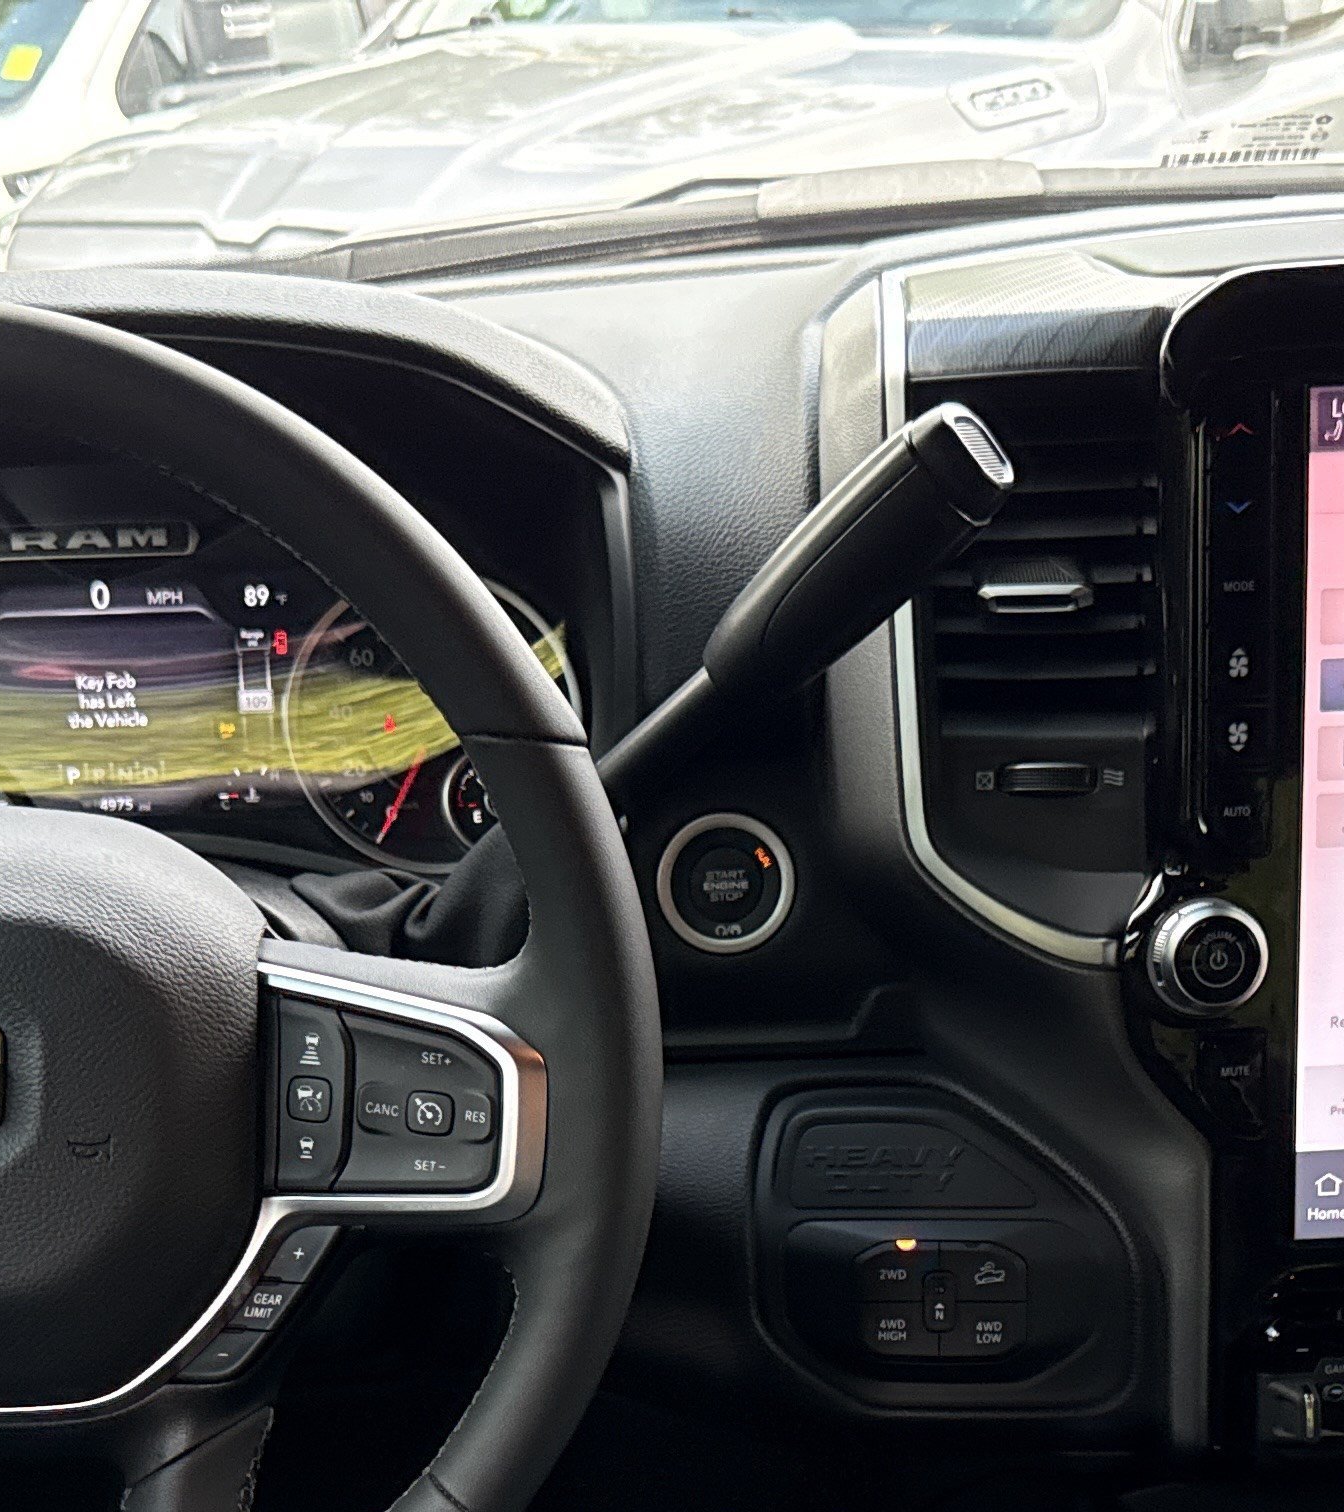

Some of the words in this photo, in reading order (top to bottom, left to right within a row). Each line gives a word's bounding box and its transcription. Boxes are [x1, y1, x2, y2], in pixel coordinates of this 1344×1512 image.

[9, 527, 168, 551] RAM
[1223, 581, 1255, 593] MODE
[89, 579, 111, 610] 0
[145, 587, 184, 606] MPH
[243, 583, 270, 608] 89
[349, 649, 374, 667] 60
[76, 673, 104, 692] Key
[106, 671, 137, 690] Fob
[78, 692, 105, 710] has
[107, 691, 137, 708] Left
[67, 713, 94, 730] the
[93, 711, 149, 728] Vehicle
[472, 809, 483, 824] E
[1222, 805, 1252, 818] AUTO
[705, 870, 746, 881] START
[703, 881, 749, 891] ENGINE
[710, 891, 744, 902] STOP
[1220, 1066, 1251, 1078] MUTE
[365, 1101, 400, 1118] CANC
[464, 1109, 486, 1124] RES
[879, 1269, 907, 1281] 2WD
[254, 1292, 283, 1306] GEAR
[244, 1305, 274, 1319] LIMIT
[935, 1309, 944, 1320] N
[879, 1319, 906, 1331] 4WD
[975, 1321, 1003, 1333] 4WD
[878, 1330, 907, 1342] HIGH
[975, 1333, 1003, 1345] LOW
